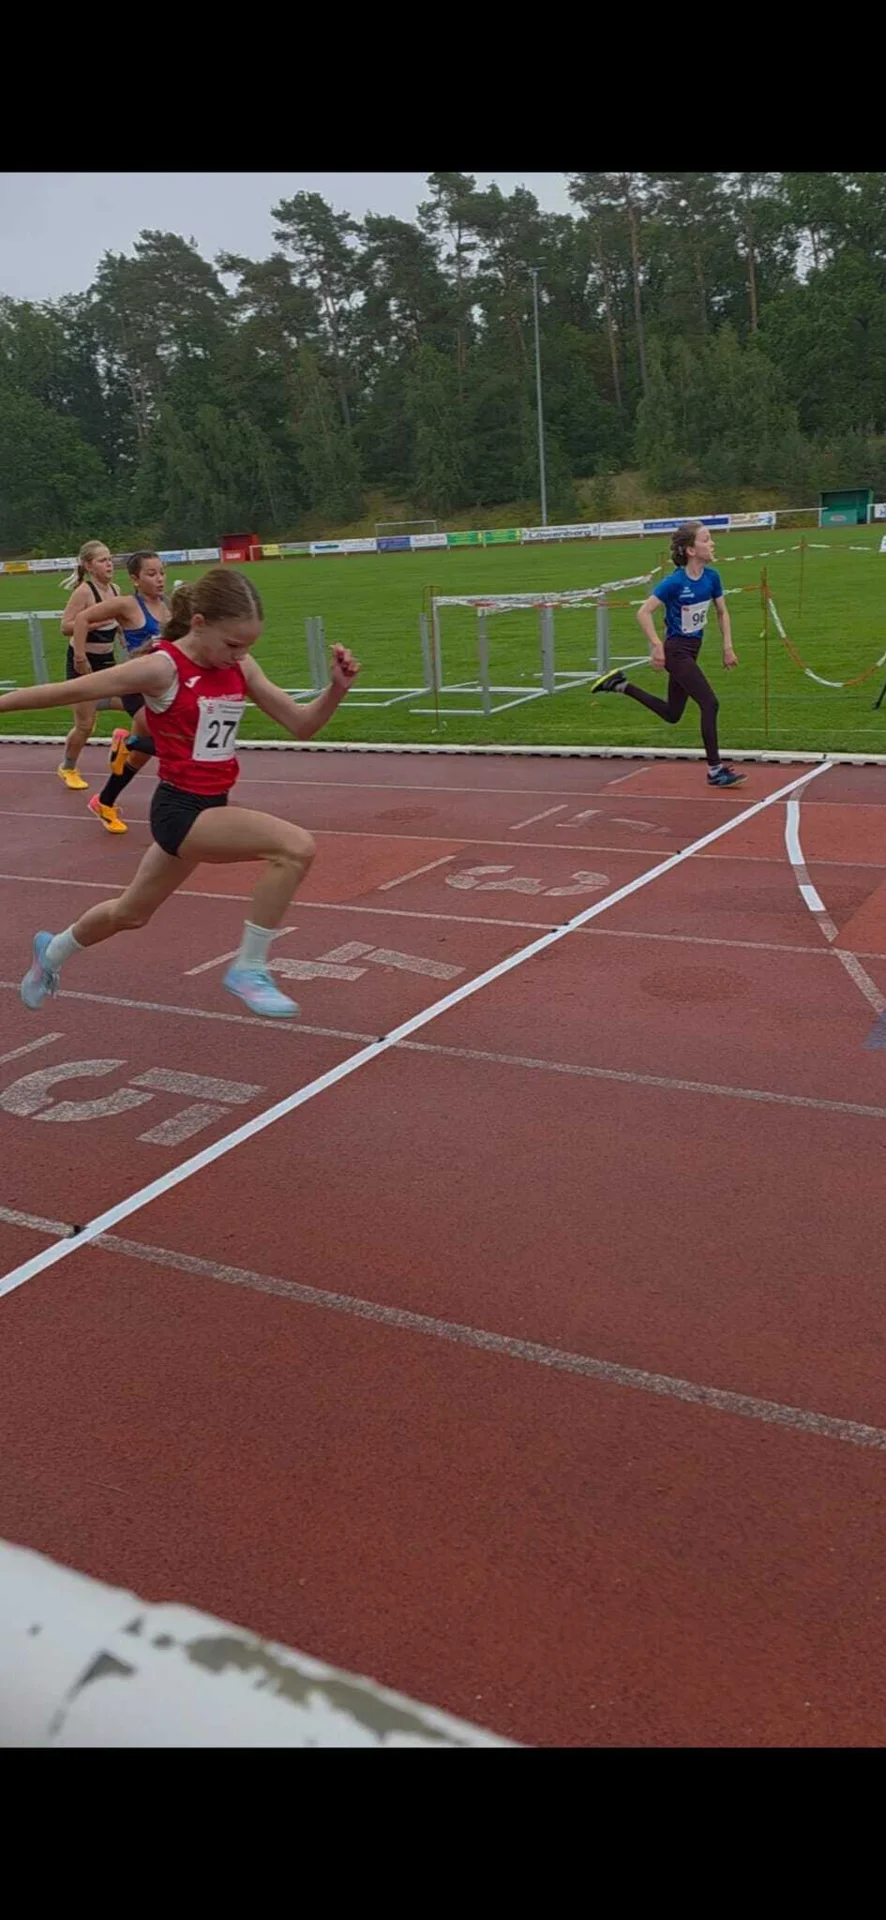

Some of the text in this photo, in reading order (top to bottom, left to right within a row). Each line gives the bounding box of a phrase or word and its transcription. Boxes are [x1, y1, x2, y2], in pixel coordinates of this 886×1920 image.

[205, 719, 237, 749] 27
[444, 864, 610, 896] 3
[0, 1058, 268, 1147] 5
